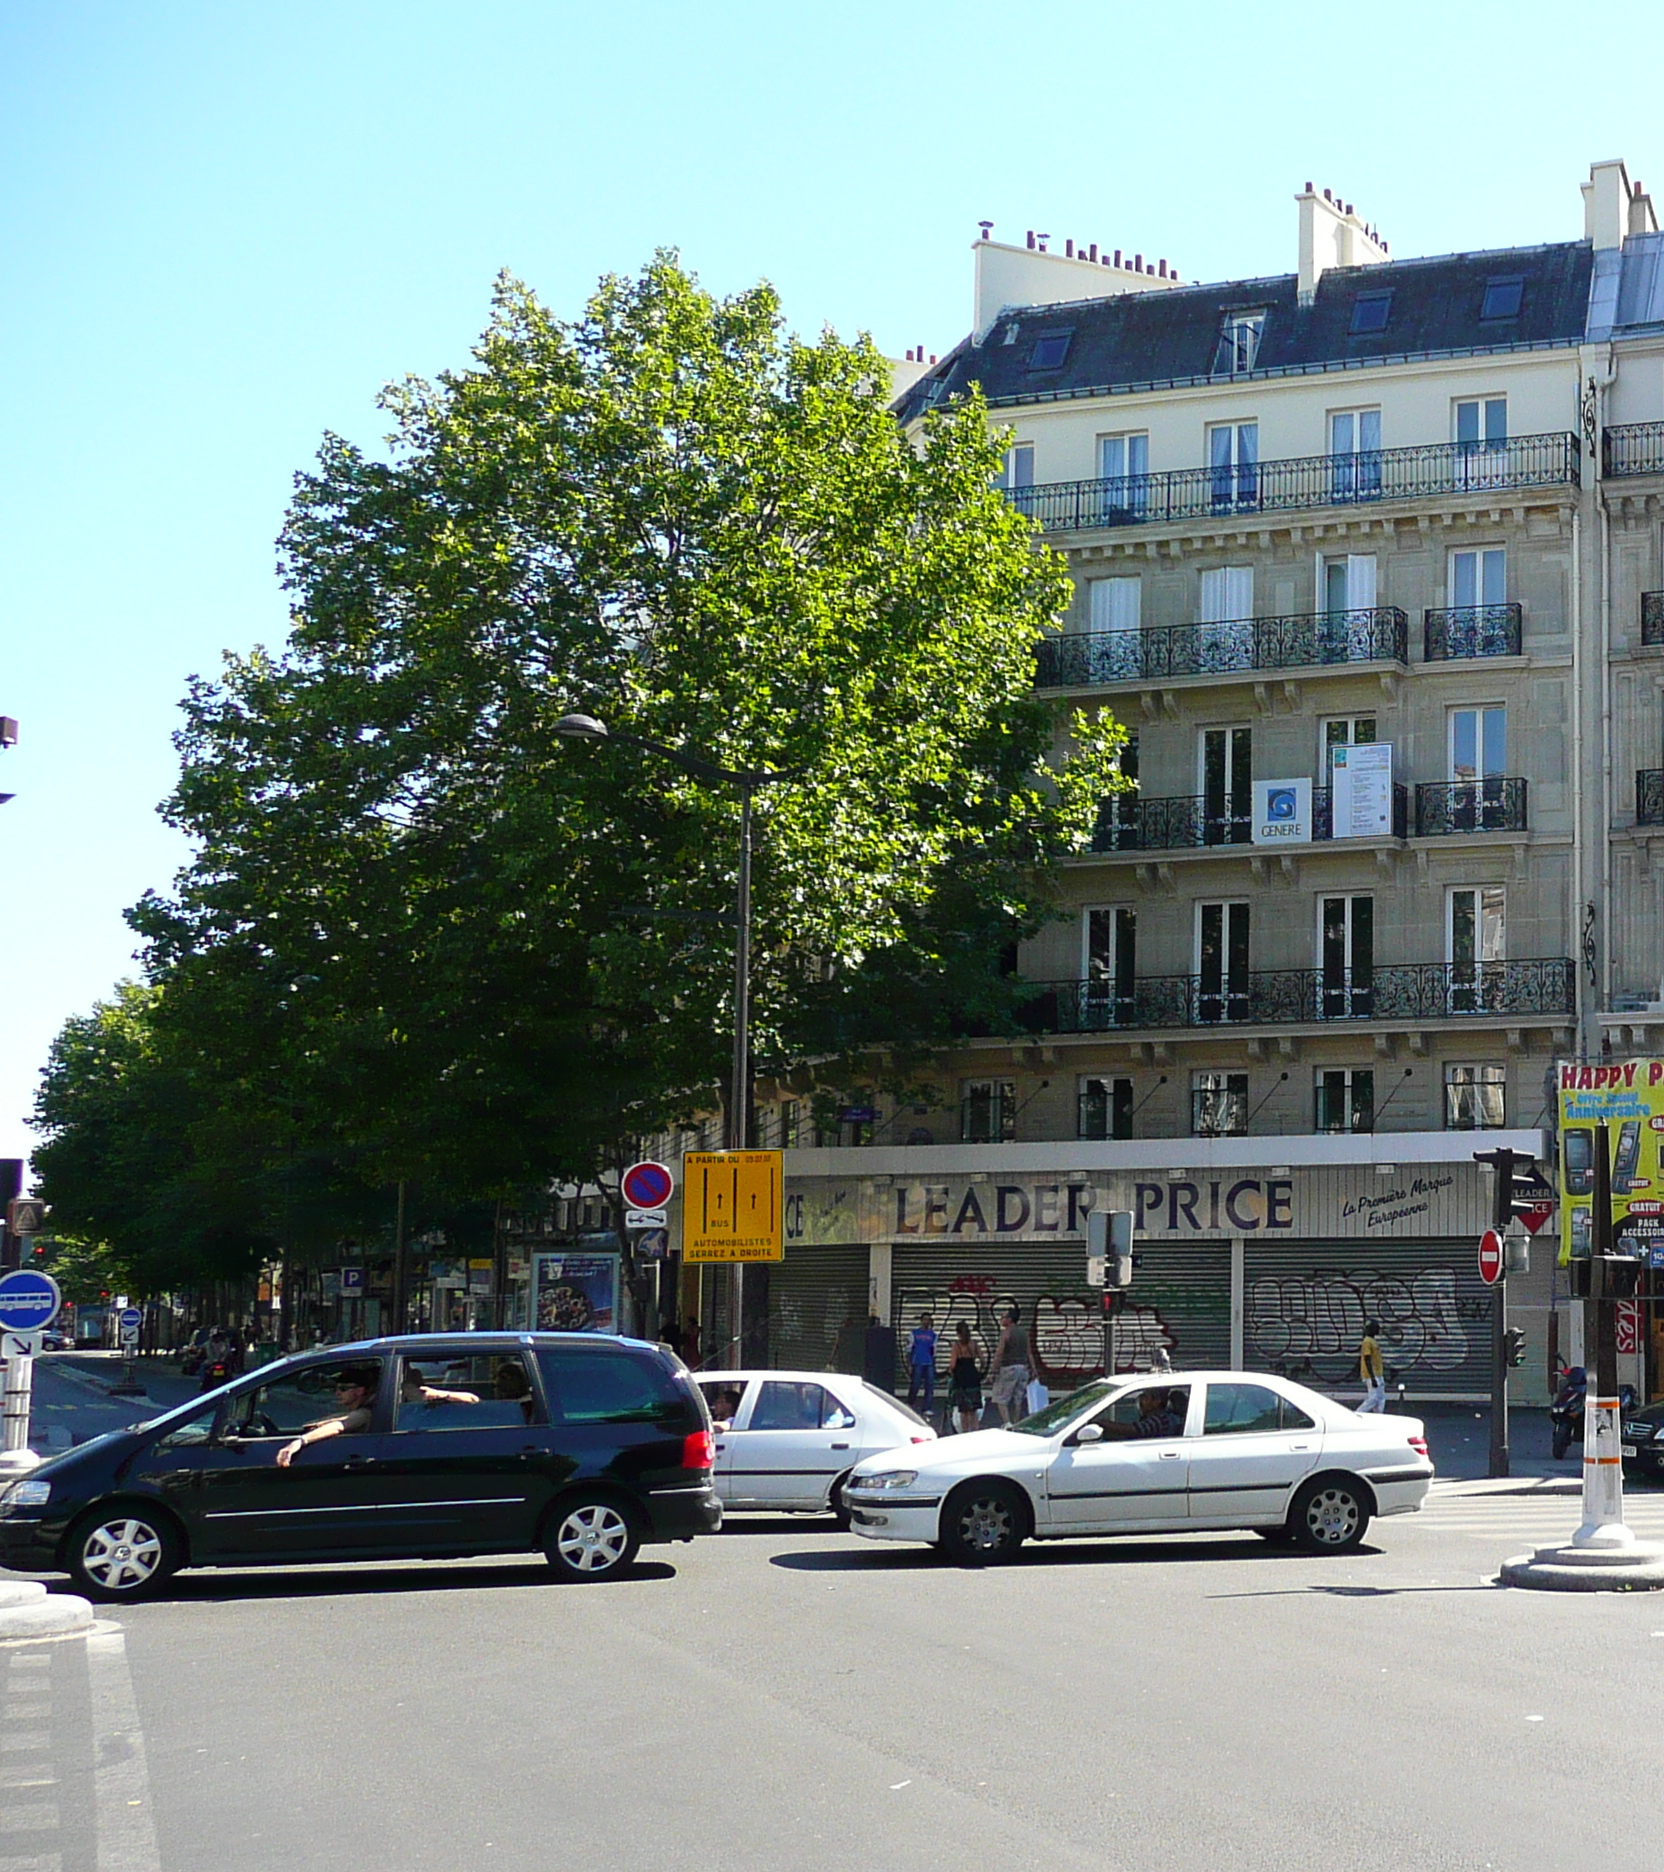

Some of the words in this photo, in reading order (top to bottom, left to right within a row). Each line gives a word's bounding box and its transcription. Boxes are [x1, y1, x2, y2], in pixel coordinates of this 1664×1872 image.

[1561, 1063, 1637, 1089] HAPPY
[1566, 1101, 1651, 1119] Anniversaire
[686, 1156, 693, 1164] A
[695, 1155, 725, 1164] PARTIR
[727, 1155, 740, 1164] DU
[1342, 1201, 1357, 1218] La
[1410, 1174, 1454, 1198] Marque
[1514, 1188, 1550, 1198] LEADER
[896, 1183, 1097, 1234] LEADER
[1134, 1179, 1294, 1231] PRICE
[1629, 1203, 1662, 1213] GRATUIT
[710, 1219, 730, 1228] BUS
[1637, 1218, 1660, 1227] PACK
[693, 1237, 772, 1247] AUTOMOBILISTES
[689, 1249, 725, 1258] SERREZ
[739, 1248, 773, 1258] DROITE
